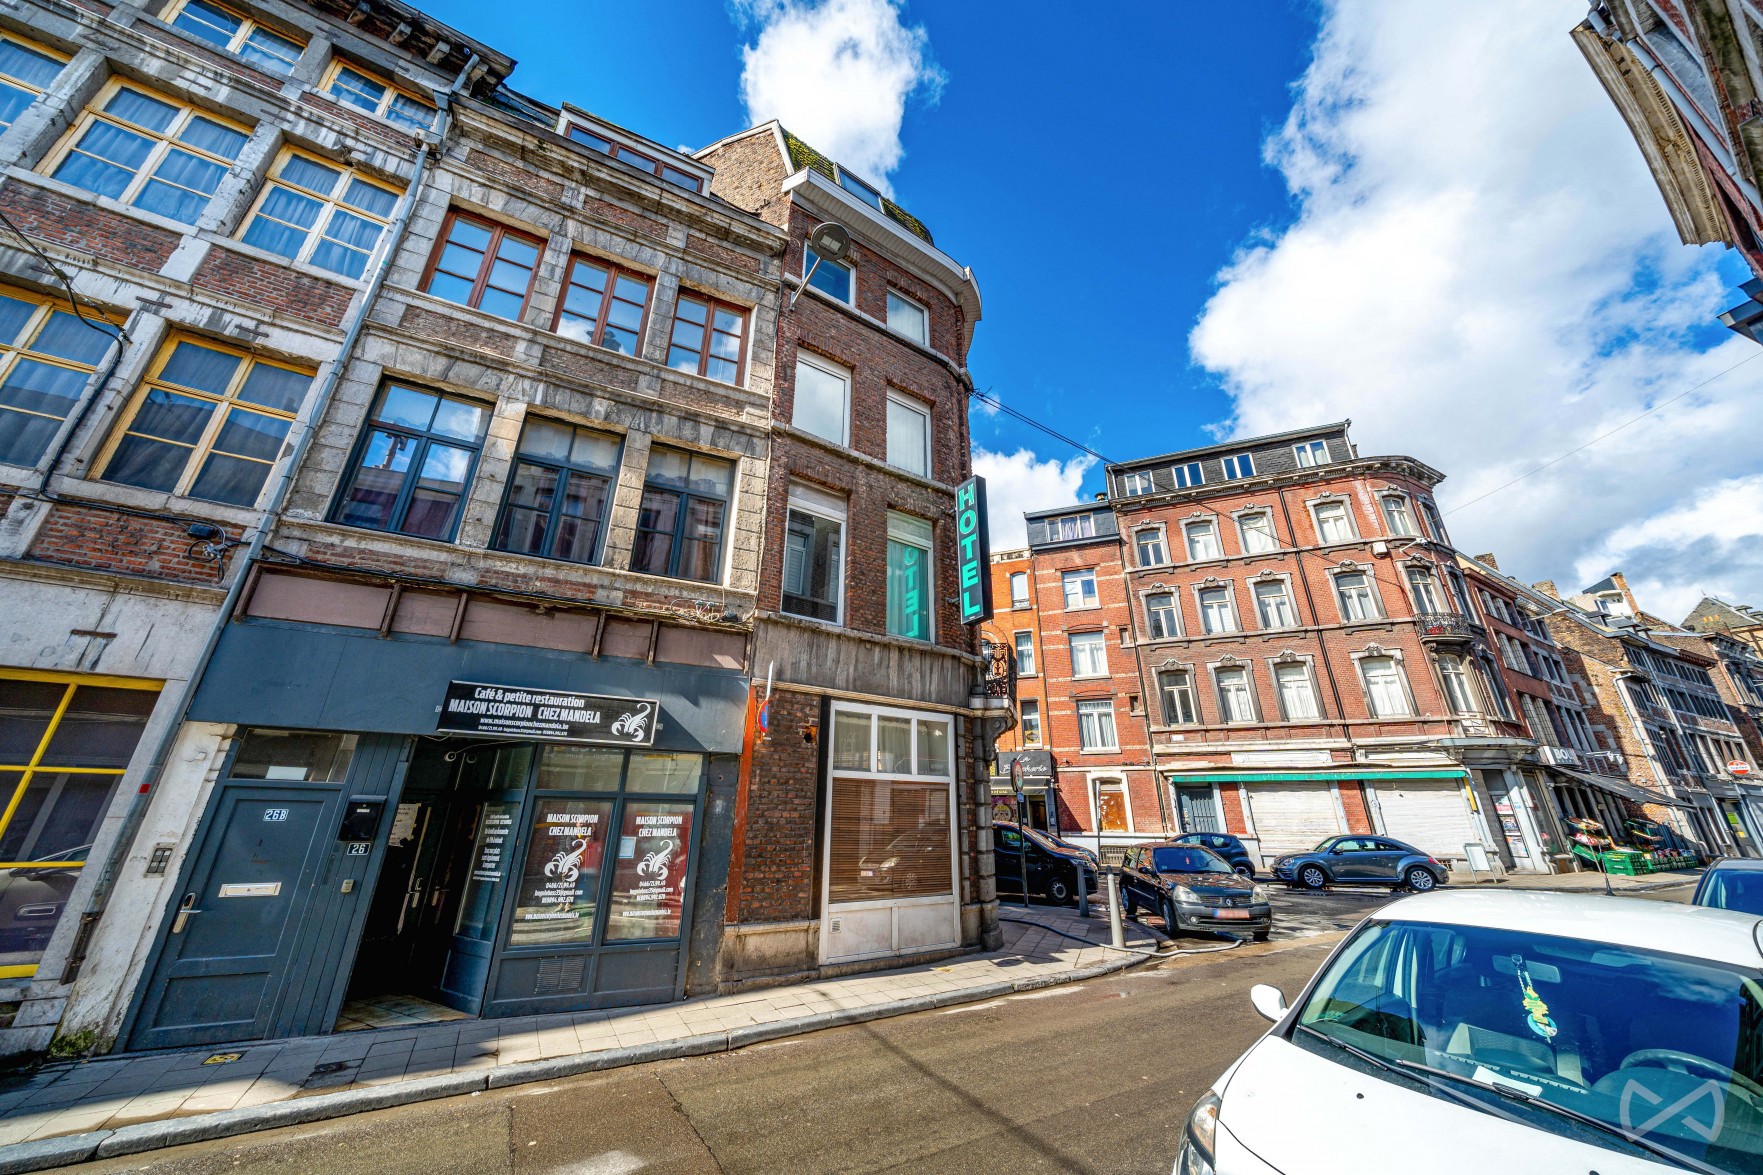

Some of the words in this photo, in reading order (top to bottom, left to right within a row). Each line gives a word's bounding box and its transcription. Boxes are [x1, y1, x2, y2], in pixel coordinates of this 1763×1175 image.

[959, 483, 981, 617] HOTEL
[474, 687, 492, 700] Café
[495, 689, 504, 700] &
[504, 690, 532, 704] petite
[531, 692, 585, 707] restauration
[448, 698, 487, 714] MAISON
[486, 702, 533, 719] SCORPION
[538, 707, 561, 721] CHEZ
[559, 708, 601, 724] MANDELA
[264, 810, 287, 820] 26B
[546, 813, 570, 823] MAISON
[570, 814, 599, 824] SCORPION
[635, 815, 657, 825] MAISON
[656, 815, 683, 825] SCORPION
[548, 826, 564, 836] CHEZ
[563, 826, 592, 836] MANDELA
[638, 828, 653, 837] CHEZ
[652, 827, 677, 836] MANDELA
[351, 844, 366, 854] 26
